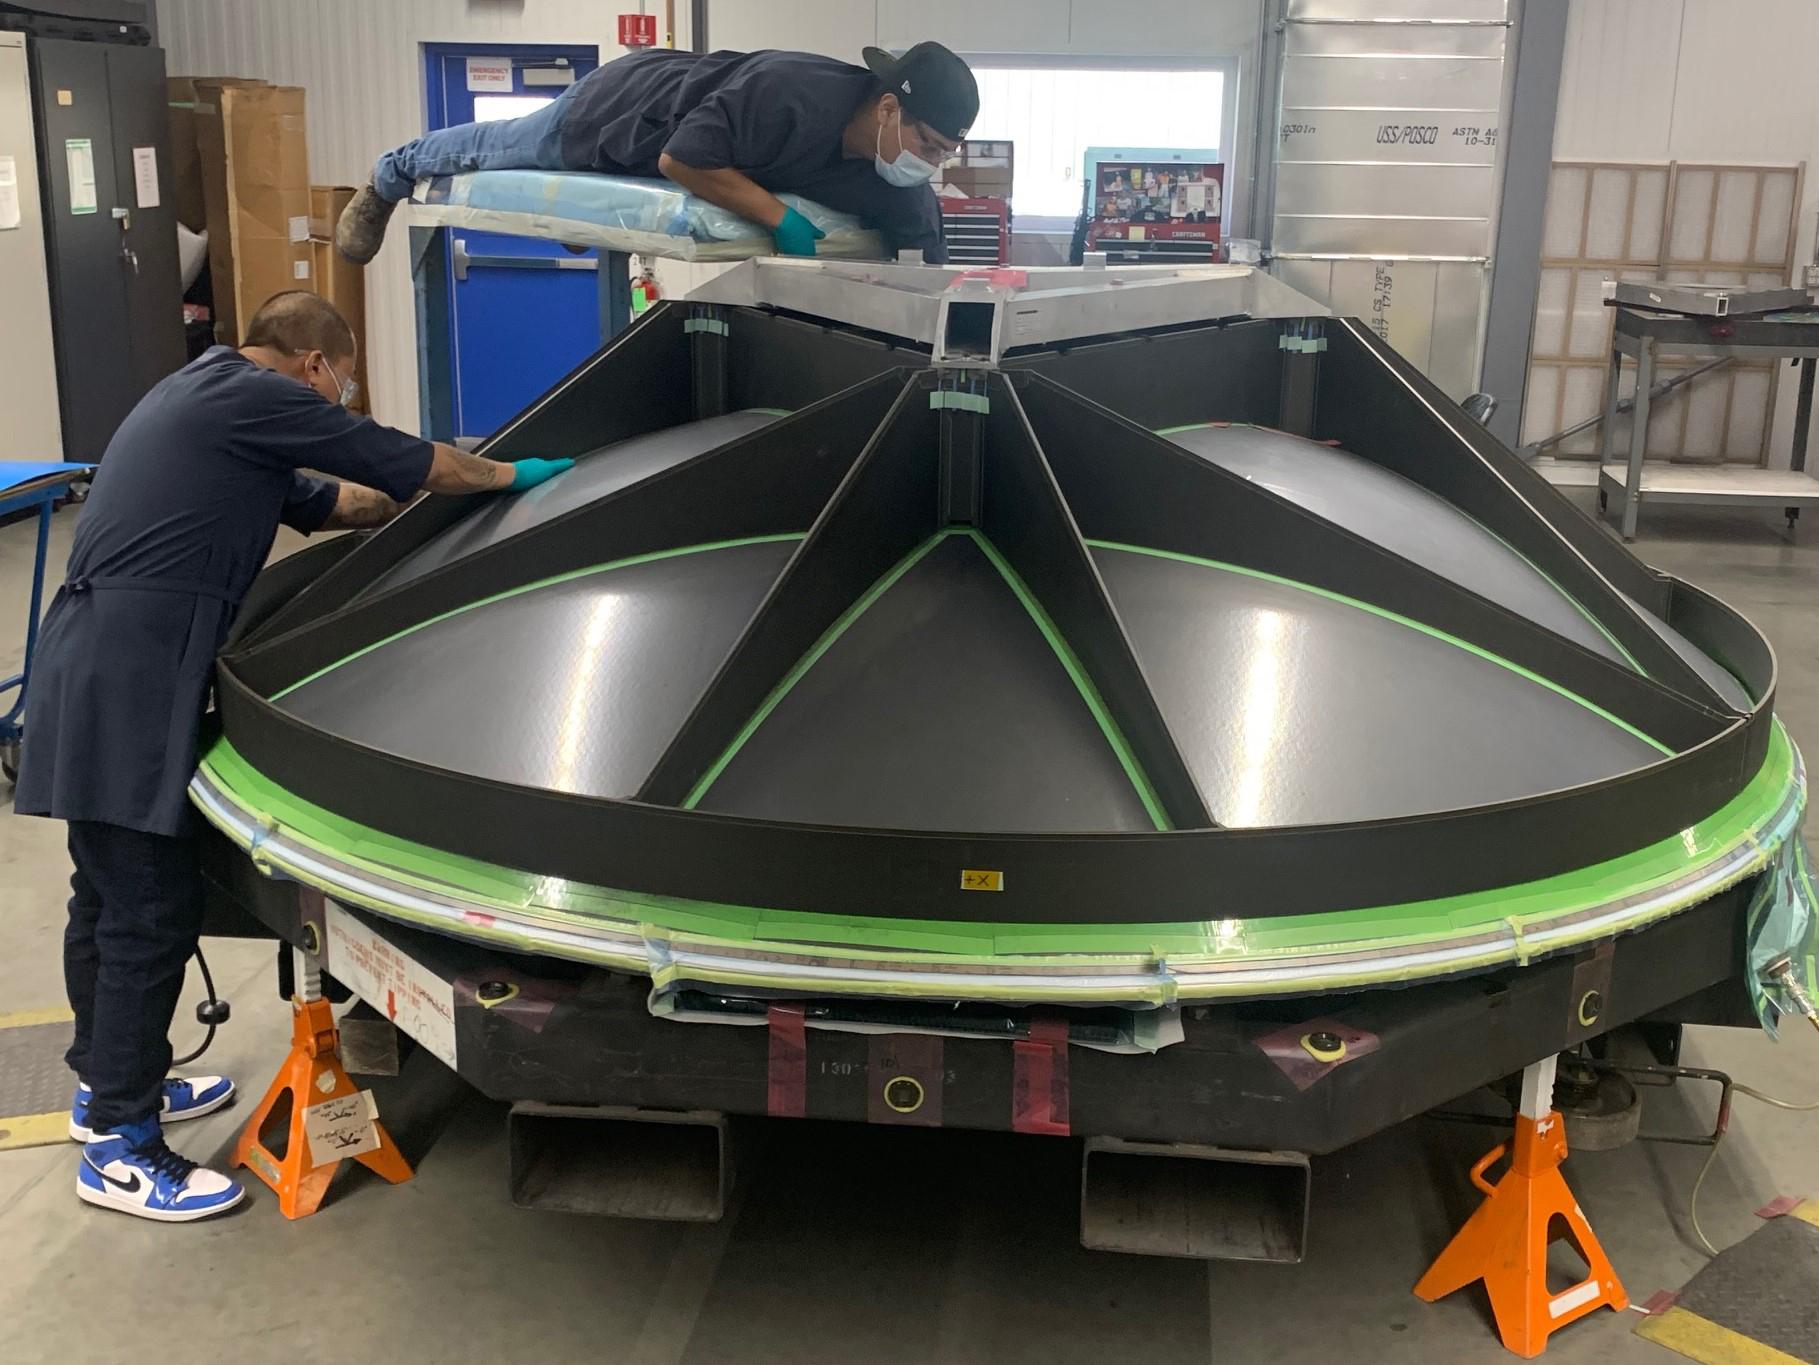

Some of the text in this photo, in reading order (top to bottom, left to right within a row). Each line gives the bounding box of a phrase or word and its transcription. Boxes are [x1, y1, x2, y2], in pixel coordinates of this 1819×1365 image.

[1376, 125, 1439, 145] USS/POSCO
[1374, 265, 1384, 292] TYPE
[1373, 298, 1382, 312] CS
